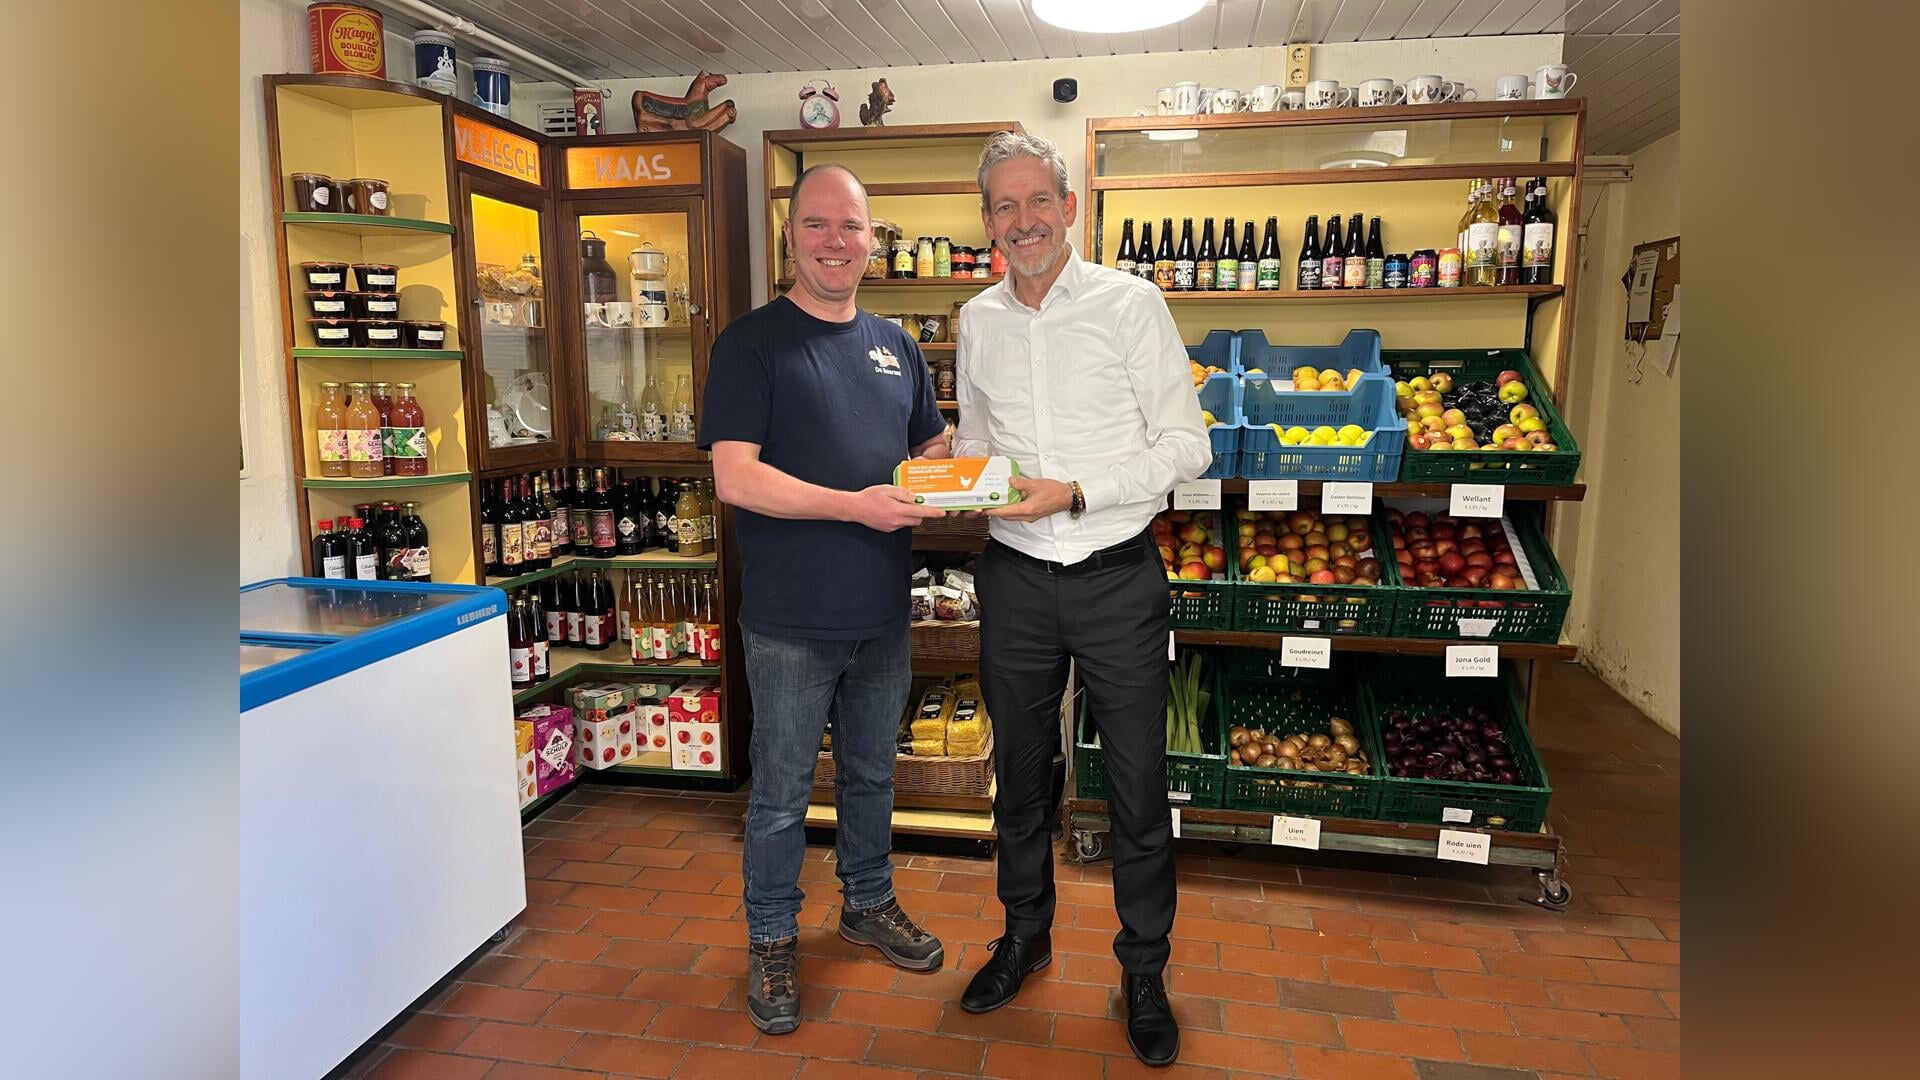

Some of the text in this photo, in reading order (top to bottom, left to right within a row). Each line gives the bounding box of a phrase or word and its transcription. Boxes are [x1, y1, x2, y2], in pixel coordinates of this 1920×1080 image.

[334, 26, 379, 46] Maggi
[341, 41, 377, 55] BOUILLON
[344, 49, 376, 61] BLOKJES
[454, 122, 538, 179] VLEESCH
[594, 153, 672, 182] KAAS
[1462, 495, 1492, 503] Wellant
[456, 604, 498, 626] LIEBHERR
[1289, 648, 1324, 656] Goudreinet
[545, 742, 569, 757] SCHULP
[1288, 827, 1304, 835] Uien
[1446, 840, 1465, 848] Rode
